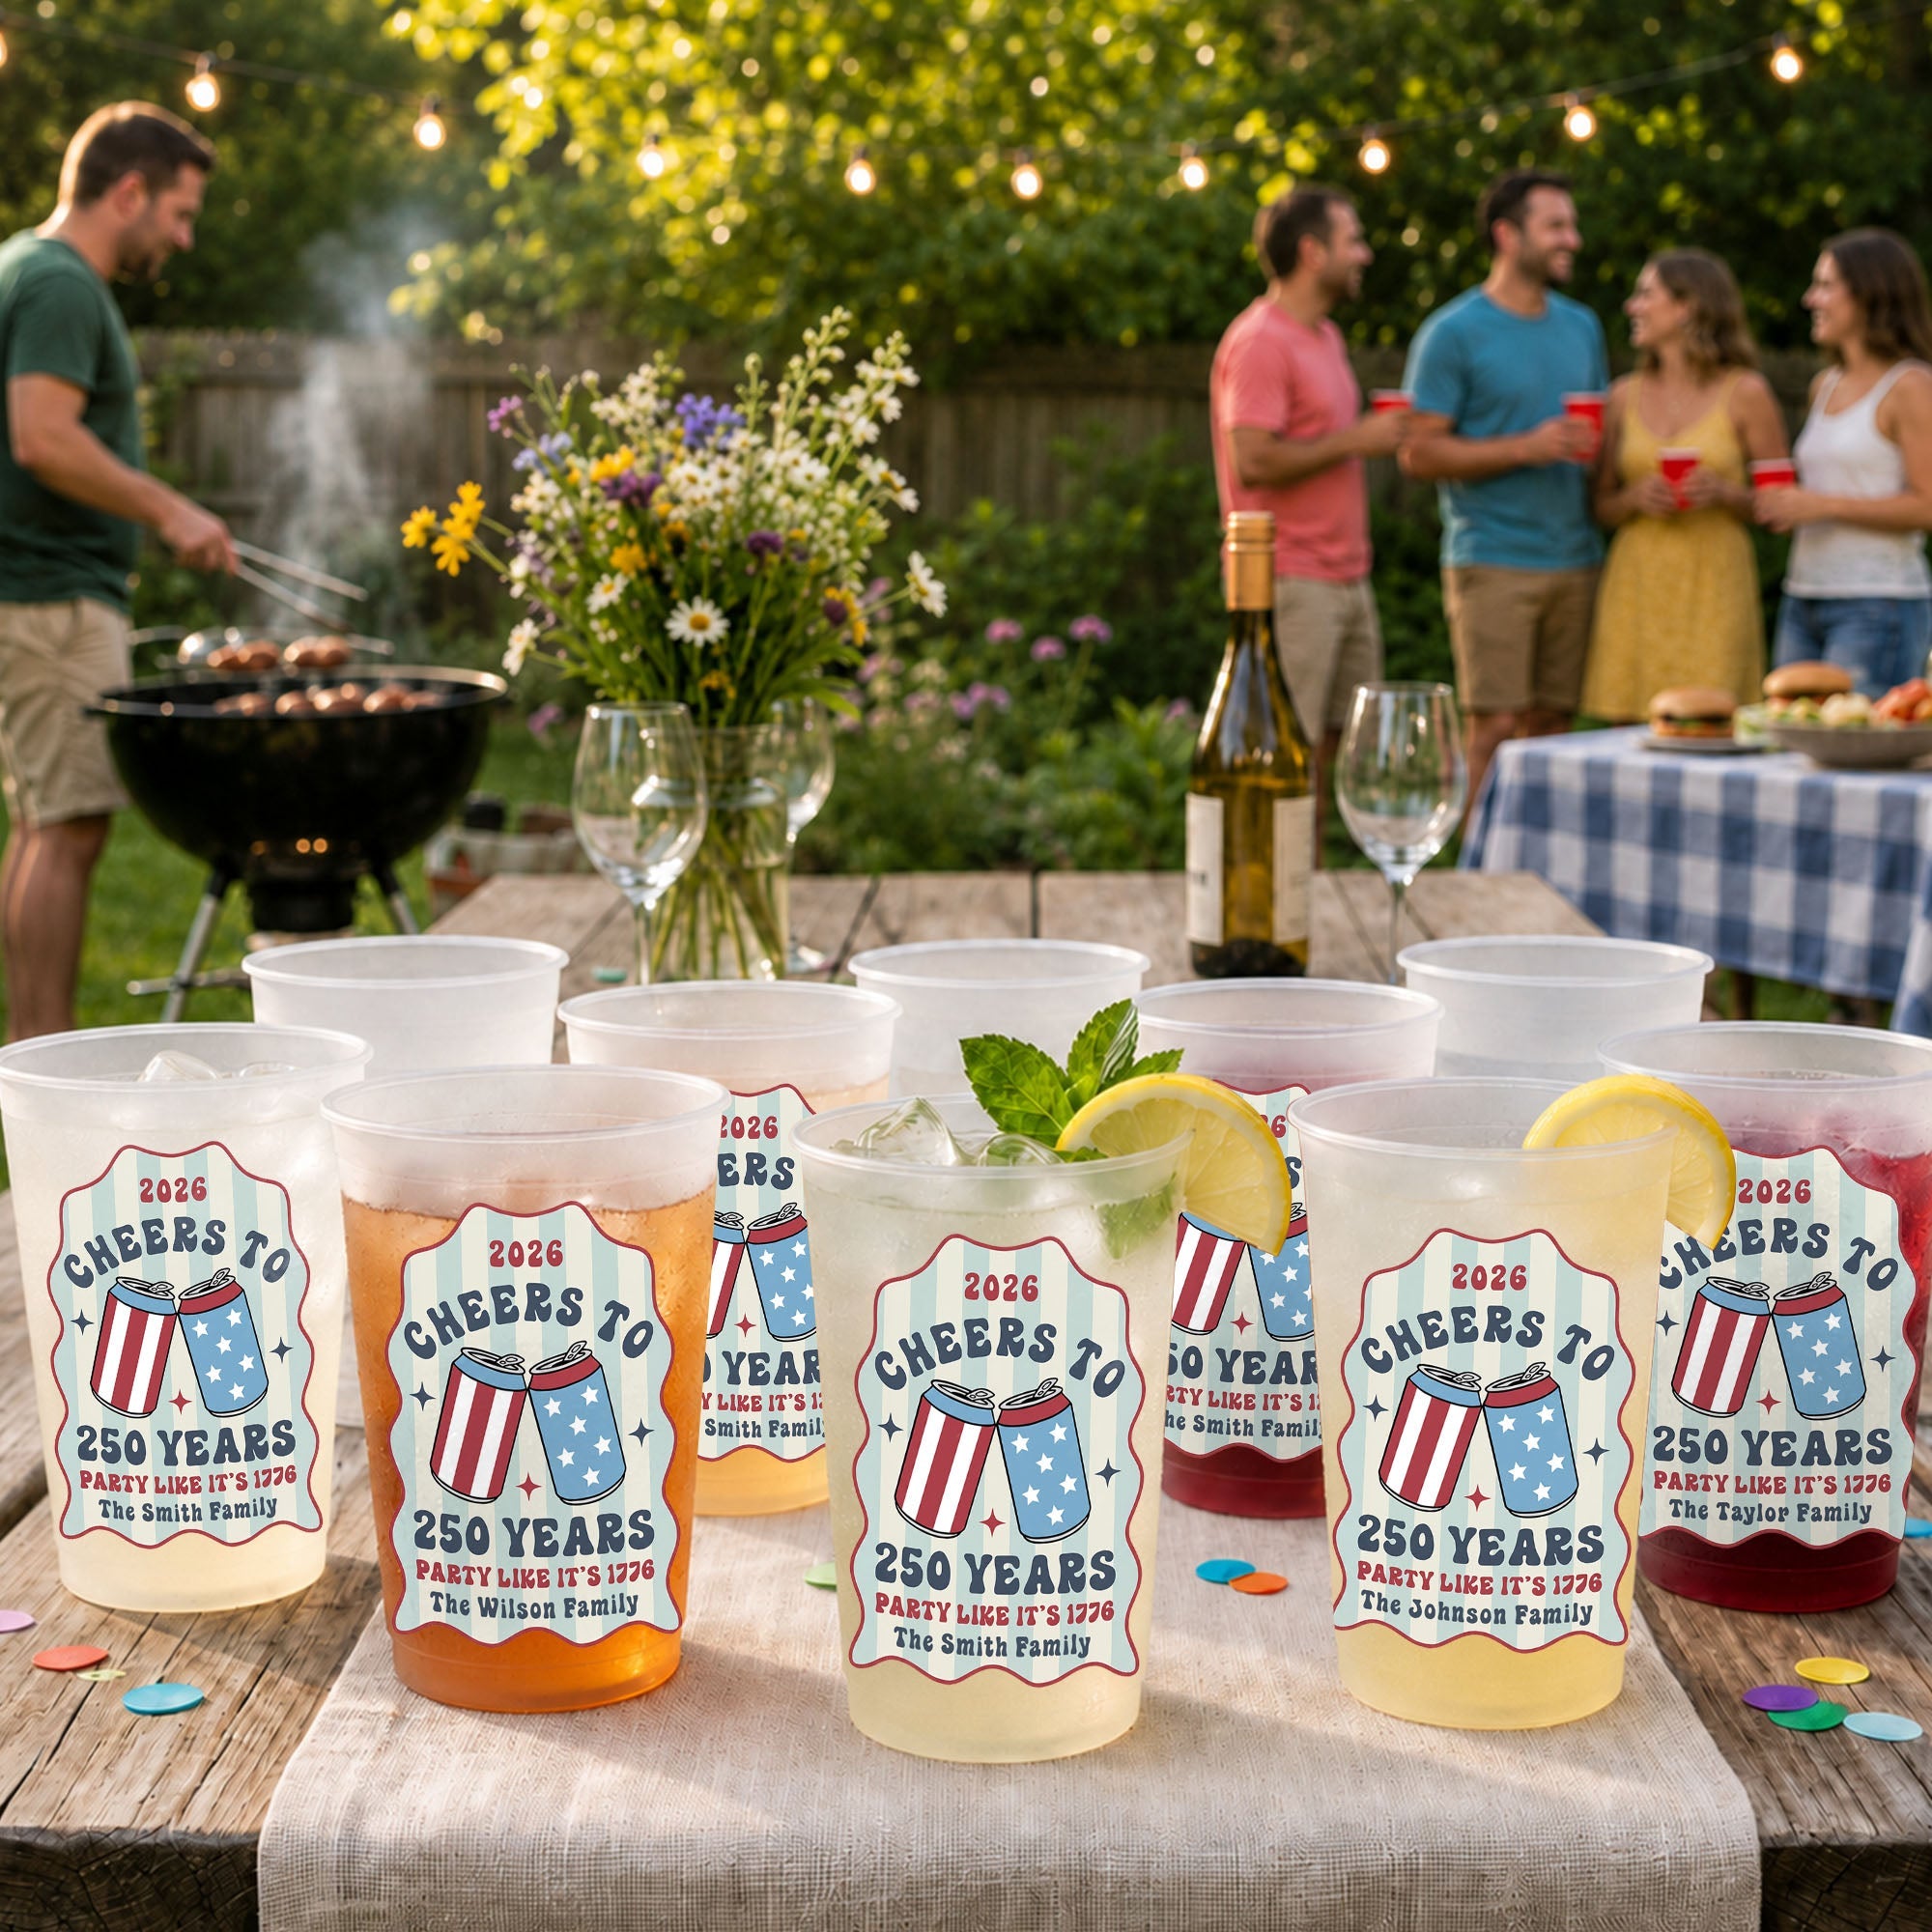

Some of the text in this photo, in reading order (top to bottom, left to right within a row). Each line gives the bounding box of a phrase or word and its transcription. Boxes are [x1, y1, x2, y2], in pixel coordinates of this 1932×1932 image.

[140, 1177, 207, 1203] 2026
[1738, 1179, 1811, 1205] 2026
[63, 1216, 291, 1290] CHEERS TO
[489, 1239, 563, 1268] 2026
[1842, 1236, 1899, 1292] TO
[964, 1272, 1038, 1302] 2026
[1452, 1263, 1527, 1291] 2026
[404, 1282, 654, 1360] CHEERS TO
[874, 1317, 1057, 1391] CHEERS
[1068, 1337, 1125, 1398] TO
[1360, 1305, 1615, 1381] CHEERS TO
[721, 1349, 820, 1386] YEAR
[718, 1394, 762, 1412] LIKE
[768, 1393, 806, 1411] IT'S
[1208, 1391, 1256, 1410] LIKE
[1263, 1394, 1302, 1411] IT'S
[76, 1419, 297, 1466] 250 YEARS
[704, 1416, 826, 1438] Smith Famil
[1193, 1415, 1254, 1436] Smith
[1261, 1418, 1321, 1438] Famil
[1653, 1425, 1893, 1467] 250 YEARS
[80, 1464, 297, 1494] PARTY LIKE IT'S 1776
[1654, 1470, 1891, 1495] PARTY LIKE IT'S 1776
[99, 1496, 277, 1522] The Smith Family
[1669, 1498, 1870, 1526] The Taylor Family
[413, 1509, 655, 1558] 250 YEARS
[1357, 1514, 1605, 1567] 250 YEARS
[416, 1558, 655, 1589] PARTY LIKE IT'S 1776
[874, 1542, 1117, 1596] 250 YEARS
[1357, 1560, 1603, 1597] PARTY LIKE IT'S 1776
[430, 1591, 639, 1620] The Wilson Family
[875, 1592, 1114, 1627] PARTY LIKE IT'S 1776
[1361, 1589, 1592, 1626] The Johnson Family
[894, 1626, 1090, 1659] The Smith Family
